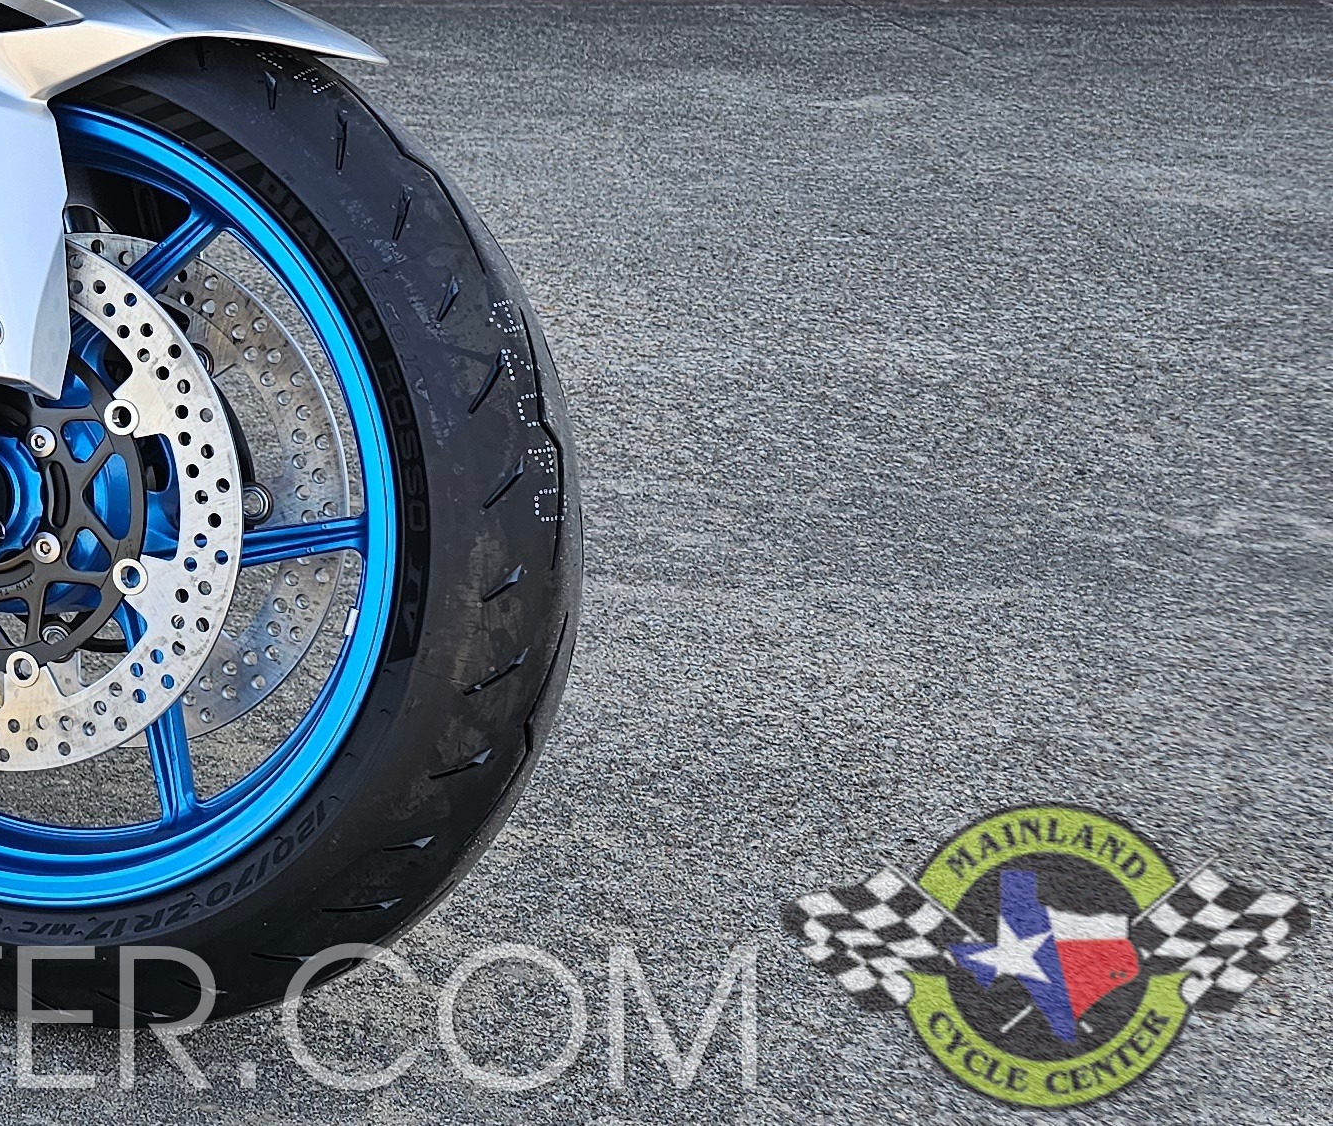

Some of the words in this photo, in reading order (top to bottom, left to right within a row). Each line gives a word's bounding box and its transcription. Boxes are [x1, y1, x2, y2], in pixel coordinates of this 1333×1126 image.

[255, 169, 382, 341] DIABLO
[379, 358, 427, 534] ROSSO
[206, 803, 329, 908] 120/70
